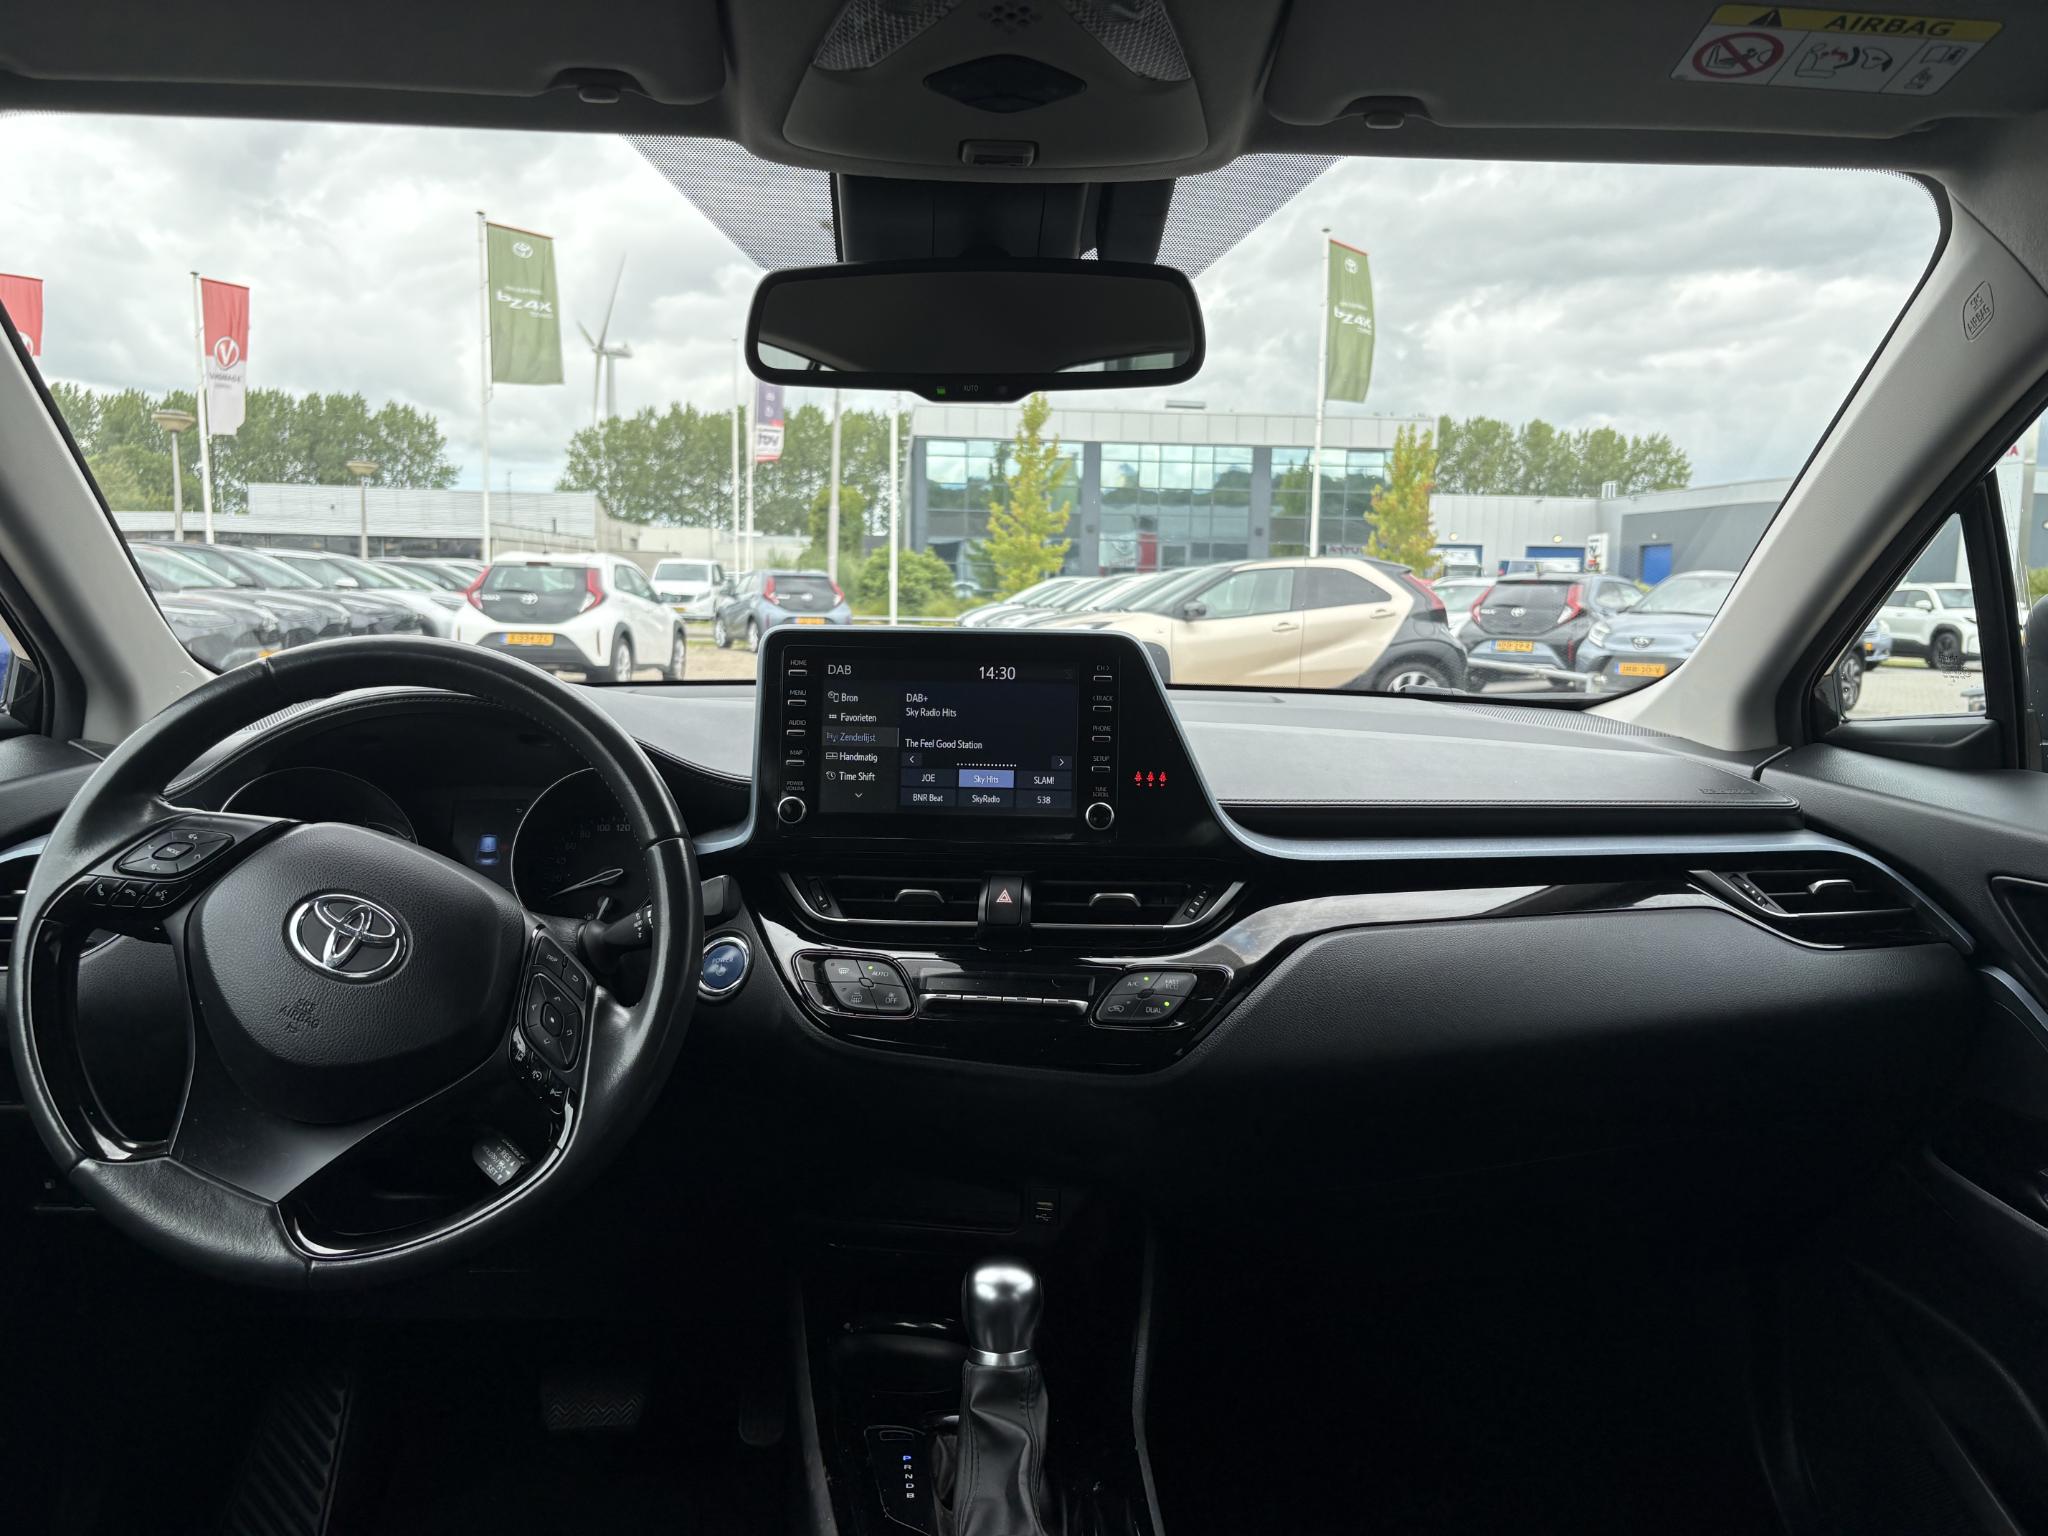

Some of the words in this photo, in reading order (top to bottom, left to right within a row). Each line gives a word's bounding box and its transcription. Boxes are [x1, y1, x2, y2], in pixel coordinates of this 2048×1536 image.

[1823, 14, 1955, 37] AIRBAG
[827, 664, 852, 675] DAB
[979, 666, 1016, 680] 14:30
[841, 693, 859, 702] Bron
[906, 693, 928, 703] DAB+
[840, 712, 877, 723] Favorieten
[906, 708, 920, 718] Sky
[920, 708, 941, 717] Radio
[942, 708, 957, 717] Hits
[840, 732, 876, 743] Zenderlijst
[905, 739, 919, 749] The
[920, 739, 935, 749] Feel
[936, 739, 956, 749] Good
[957, 740, 983, 750] Station
[839, 752, 878, 763] Handmatig
[839, 771, 857, 781] Time
[858, 771, 876, 781] Shift
[921, 774, 936, 782] JOE
[973, 775, 985, 784] Sky
[986, 775, 999, 784] Hits
[1033, 776, 1055, 785] SLAM!
[912, 794, 928, 802] BNR
[929, 794, 944, 802] Beat
[972, 794, 1001, 804] SkyRadio
[1037, 796, 1051, 804] 538
[615, 824, 631, 832] 120
